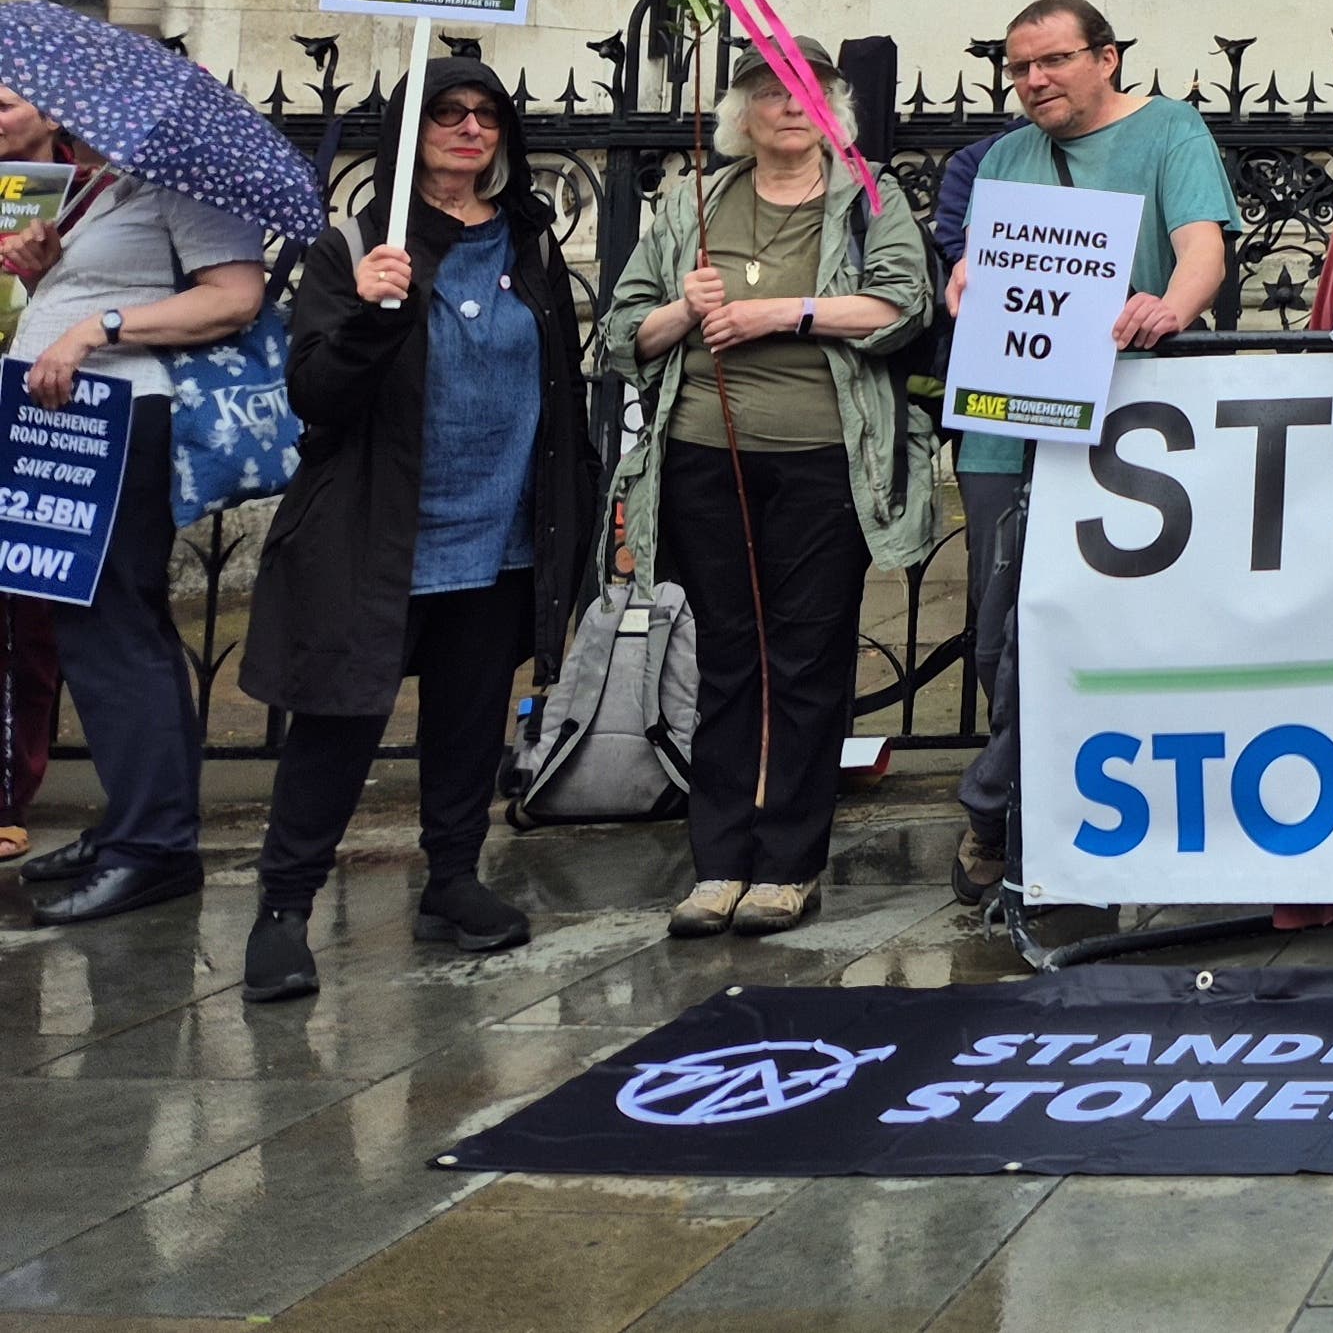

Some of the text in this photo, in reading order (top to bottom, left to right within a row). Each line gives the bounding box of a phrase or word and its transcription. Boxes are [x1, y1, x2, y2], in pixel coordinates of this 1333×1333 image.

[2, 203, 40, 215] World
[992, 222, 1108, 249] PLANNING
[978, 249, 1116, 279] INSPECTORS
[1004, 286, 1071, 317] SAY
[1004, 330, 1052, 360] NO
[17, 406, 109, 436] STONEHENGE
[213, 385, 289, 428] Kew
[966, 393, 1082, 419] SAVE STONEHENGE
[9, 424, 109, 458] ROAD SCHEME
[13, 457, 96, 486] SAVE OVER
